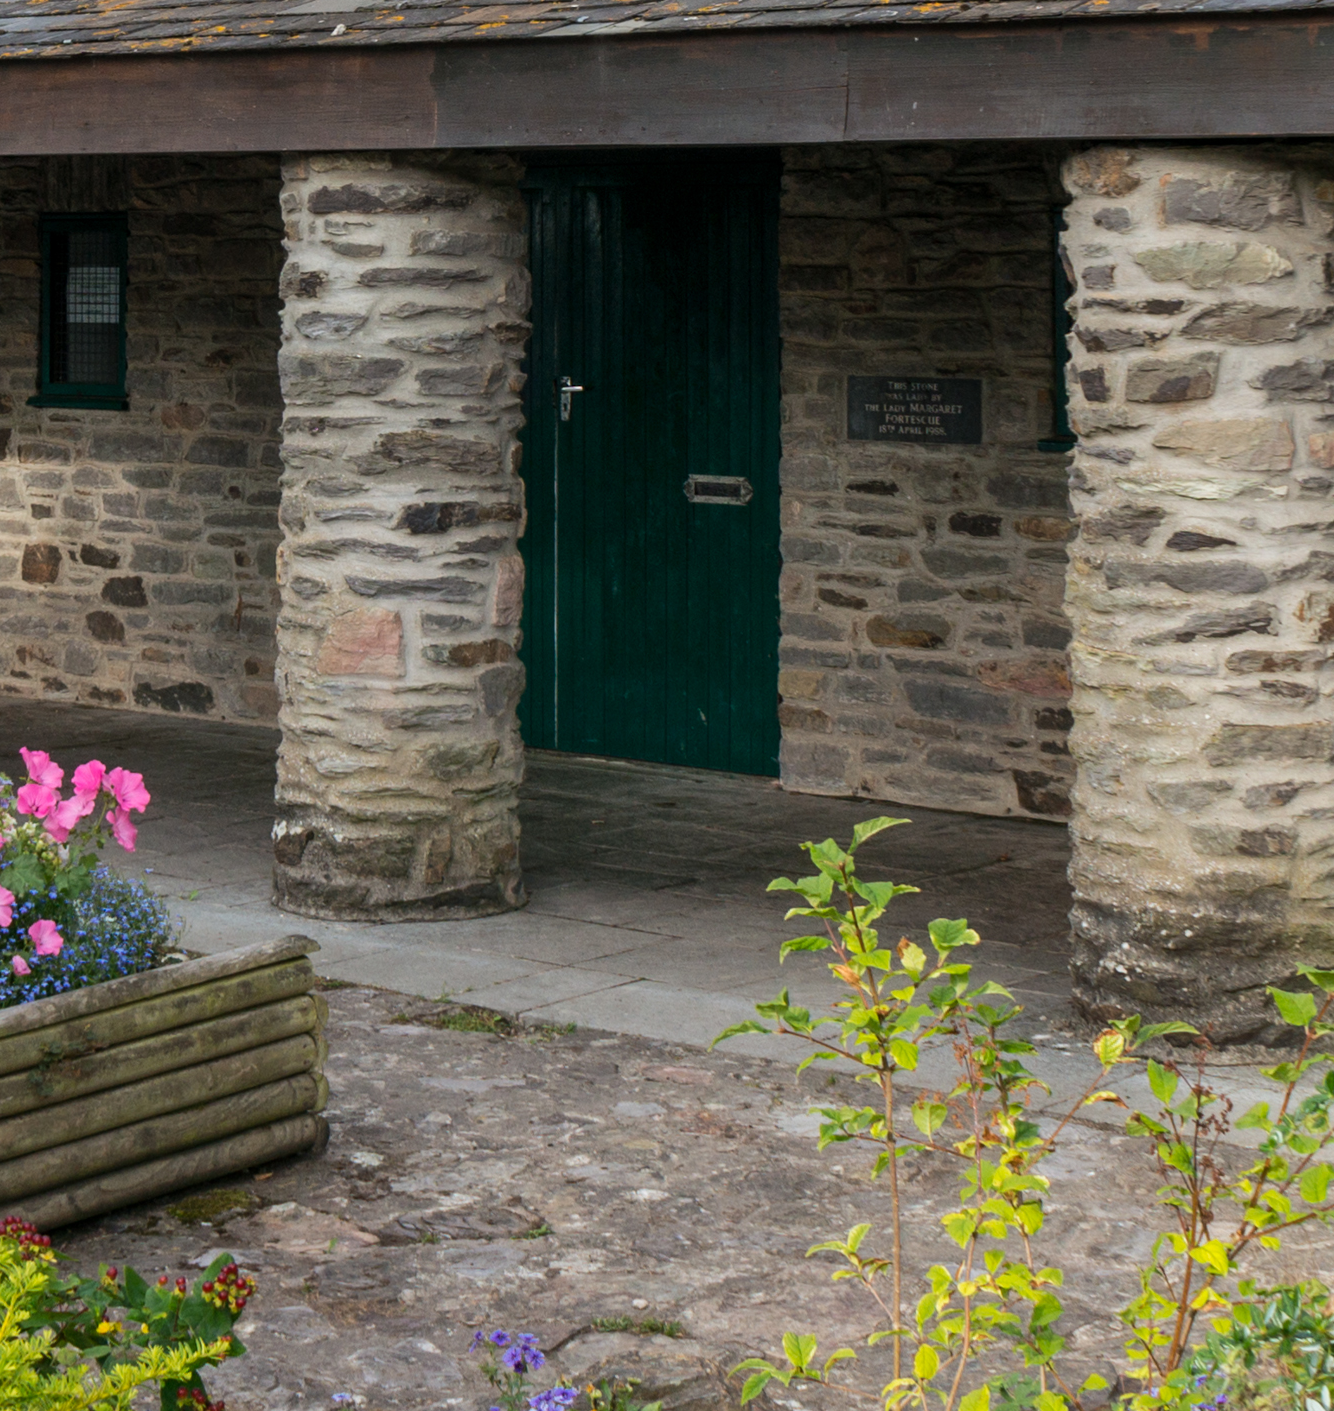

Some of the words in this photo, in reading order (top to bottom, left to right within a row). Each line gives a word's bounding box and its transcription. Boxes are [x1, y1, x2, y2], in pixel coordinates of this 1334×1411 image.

[887, 381, 907, 391] THIS
[911, 382, 938, 391] STONE
[931, 394, 942, 402] BY
[864, 403, 880, 412] THE
[883, 404, 906, 412] LADY
[909, 403, 963, 414] MARGARET
[885, 413, 941, 425] FORTESCUE
[898, 425, 923, 435] APRIL
